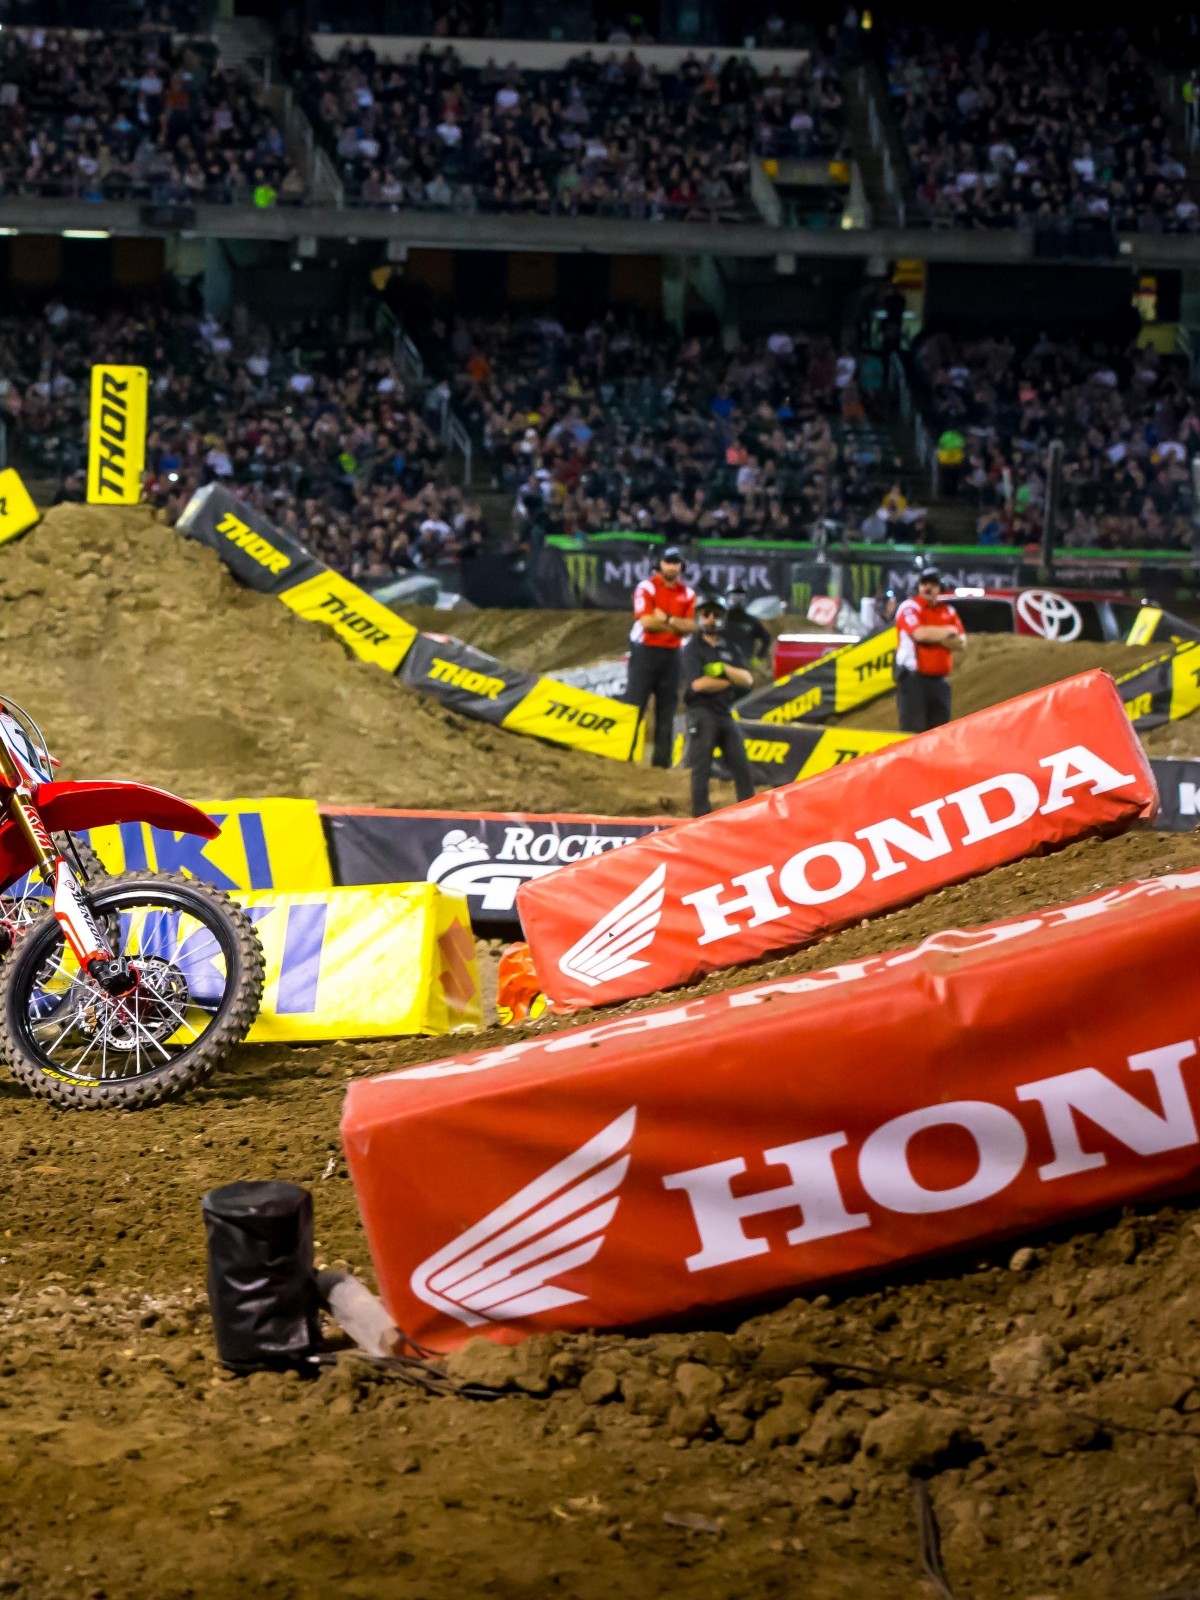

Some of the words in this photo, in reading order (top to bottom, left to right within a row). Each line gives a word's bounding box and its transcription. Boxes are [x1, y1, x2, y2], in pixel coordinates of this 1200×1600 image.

[99, 372, 128, 497] THOR
[215, 512, 291, 575] THOR
[604, 558, 772, 590] MOSTER
[319, 592, 391, 646] THOR
[428, 658, 506, 700] THOR
[854, 650, 896, 682] THO
[544, 700, 617, 735] THOR
[22, 805, 54, 850] KYB
[681, 745, 1136, 946] HONDA
[662, 1040, 1200, 1273] HON
